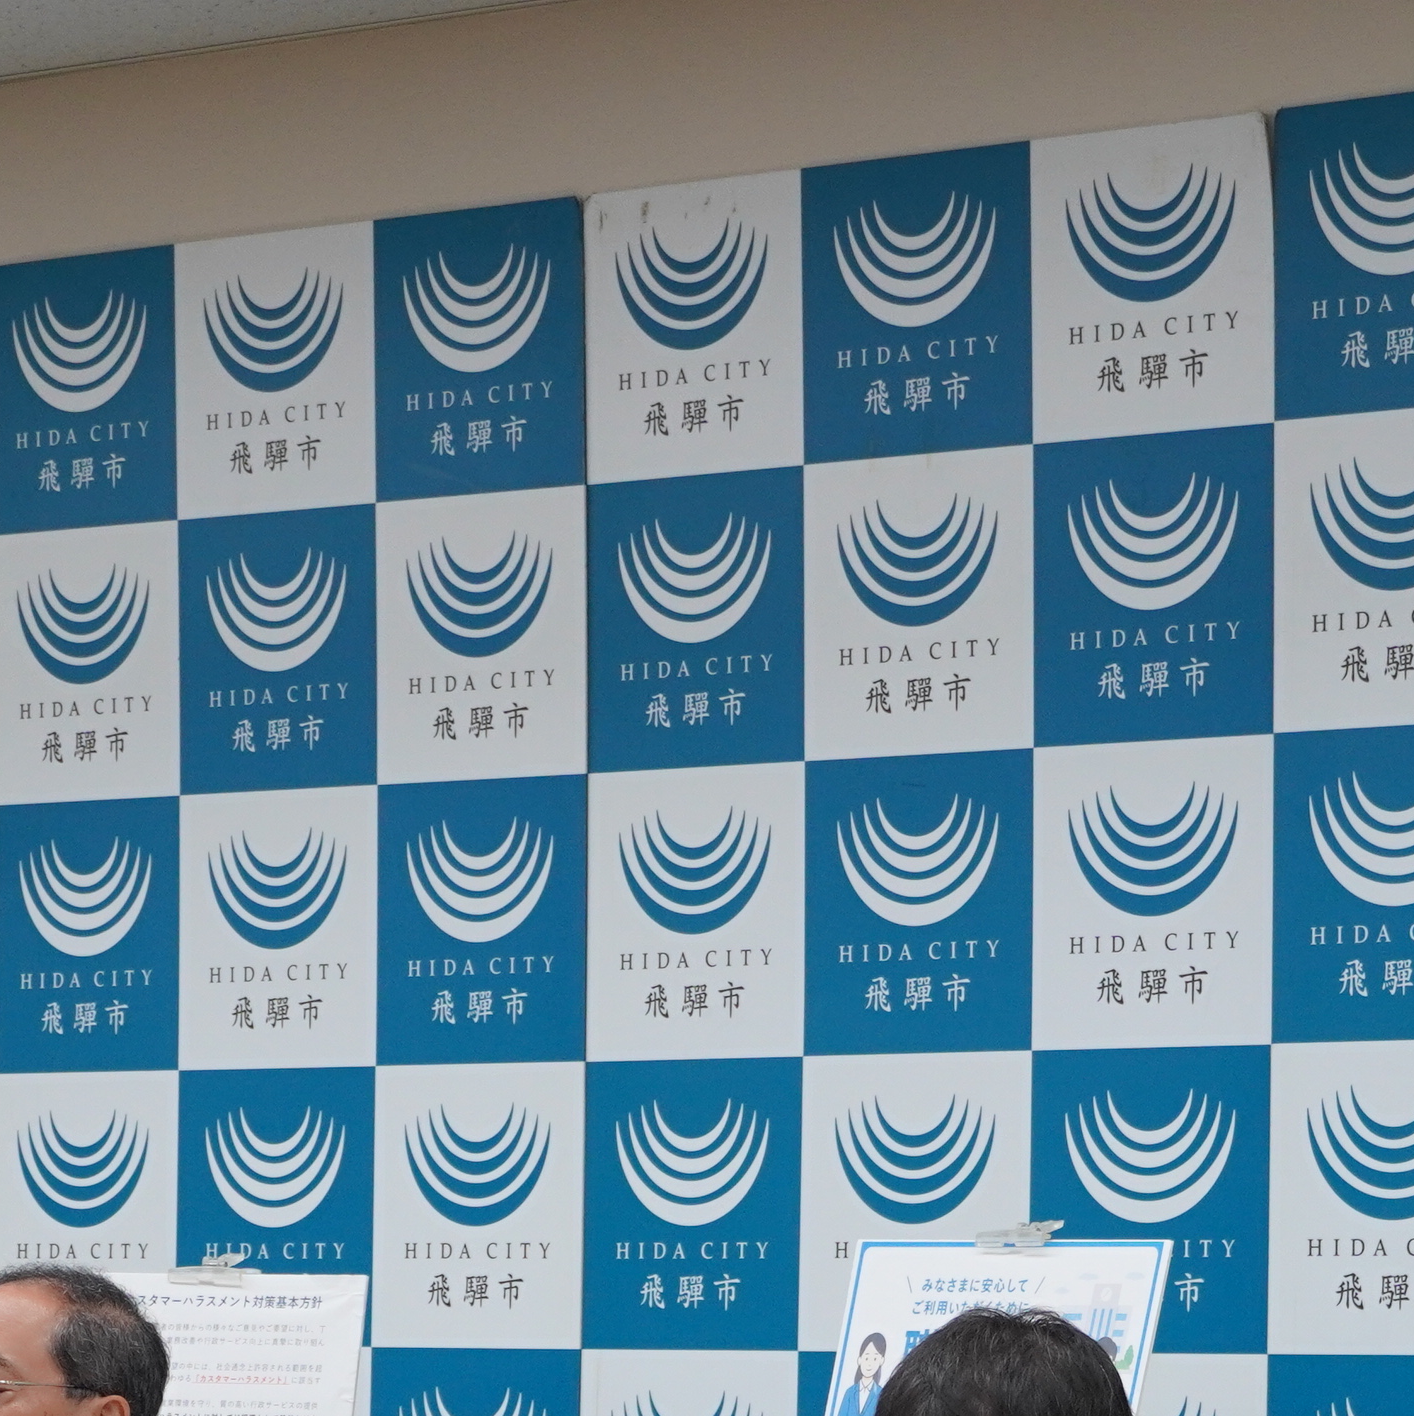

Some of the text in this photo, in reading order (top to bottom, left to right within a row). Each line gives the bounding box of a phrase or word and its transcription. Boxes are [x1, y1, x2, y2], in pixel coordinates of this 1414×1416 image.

[1312, 294, 1392, 319] HIDA
[1069, 311, 1238, 345] HIDA CITY
[838, 335, 998, 368] HIDA CITY
[619, 359, 770, 391] HIDA CITY
[407, 381, 552, 411] HIDA CITY
[207, 401, 345, 430] HIDA CITY
[17, 421, 148, 449] HIDA CITY
[1312, 610, 1392, 632] HIDA
[1070, 621, 1239, 650] HIDA CITY
[839, 638, 999, 666] HIDA CITY
[621, 654, 772, 681] HIDA CITY
[409, 669, 554, 694] HIDA CITY
[210, 683, 348, 707] HIDA CITY
[20, 696, 151, 719] HIDA CITY
[1070, 931, 1238, 954] HIDA CITY
[1311, 924, 1391, 945] HIDA
[620, 948, 772, 970] HIDA CITY
[839, 940, 999, 962] HIDA CITY
[210, 963, 347, 983] HIDA CITY
[408, 956, 554, 977] HIDA CITY
[21, 970, 152, 989] HIDA CITY
[16, 1243, 149, 1259] HIDA CITY
[282, 1242, 345, 1260] CITY
[405, 1242, 550, 1259] HIDA CITY
[616, 1242, 768, 1259] HIDA CITY
[1183, 1239, 1235, 1258] ITY
[1308, 1239, 1387, 1256] HIDA
[921, 1278, 1029, 1293] みなさまに安心して
